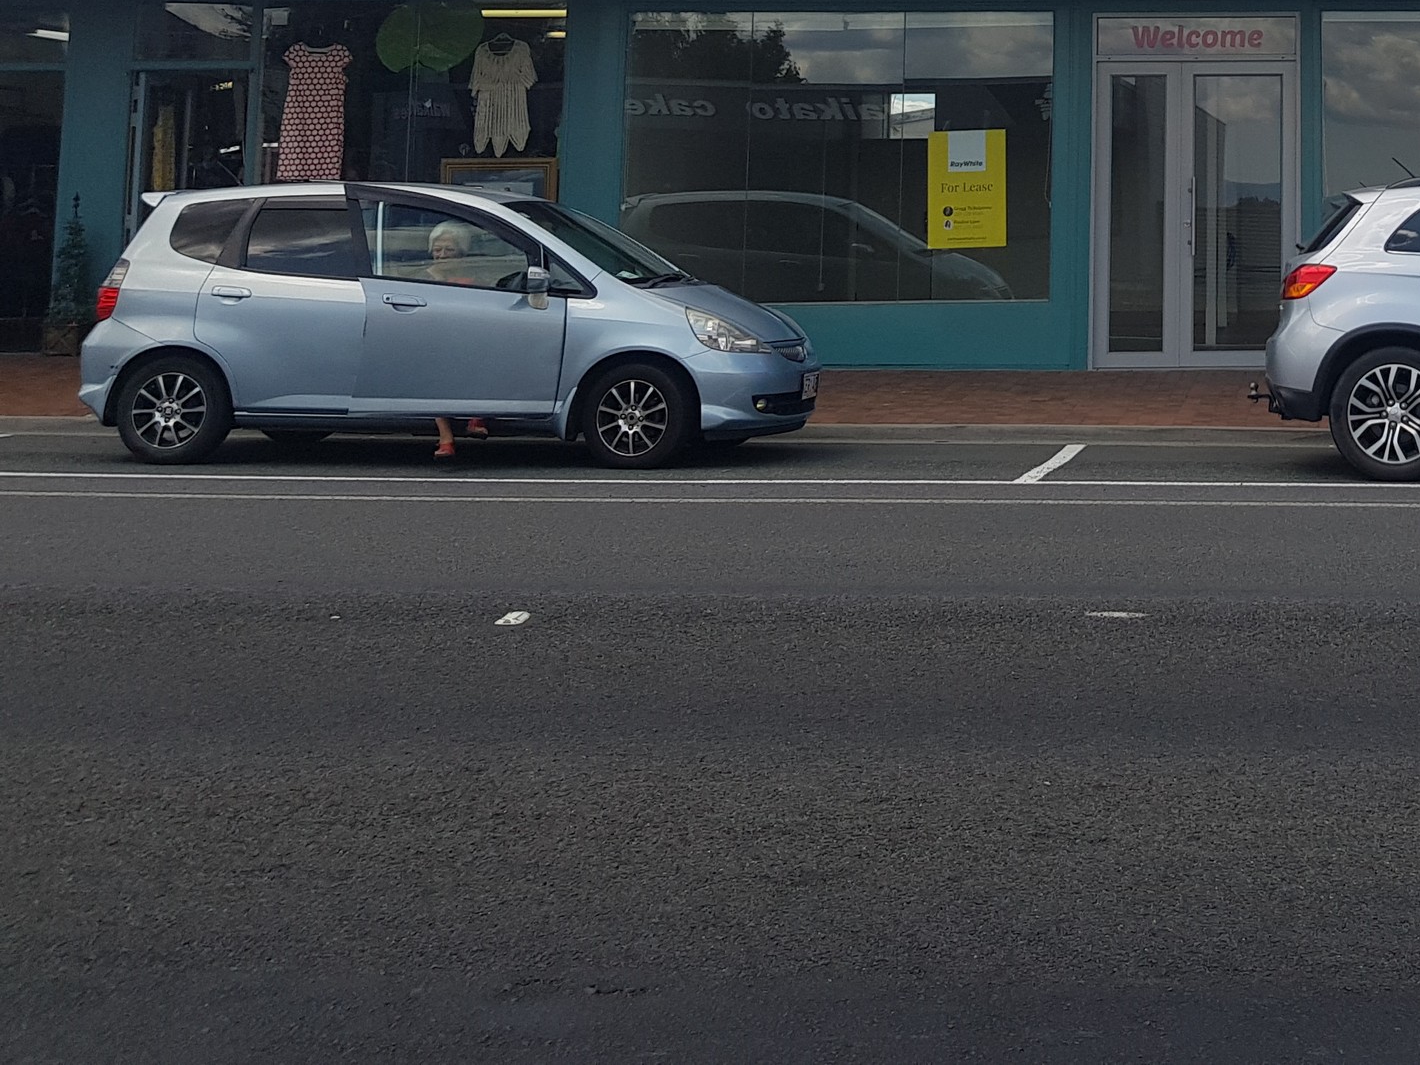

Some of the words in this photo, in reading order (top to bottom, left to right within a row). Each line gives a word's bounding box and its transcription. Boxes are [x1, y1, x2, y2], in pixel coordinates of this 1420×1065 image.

[1131, 25, 1264, 49] Welcome
[941, 183, 959, 193] For
[963, 182, 993, 192] Lease
